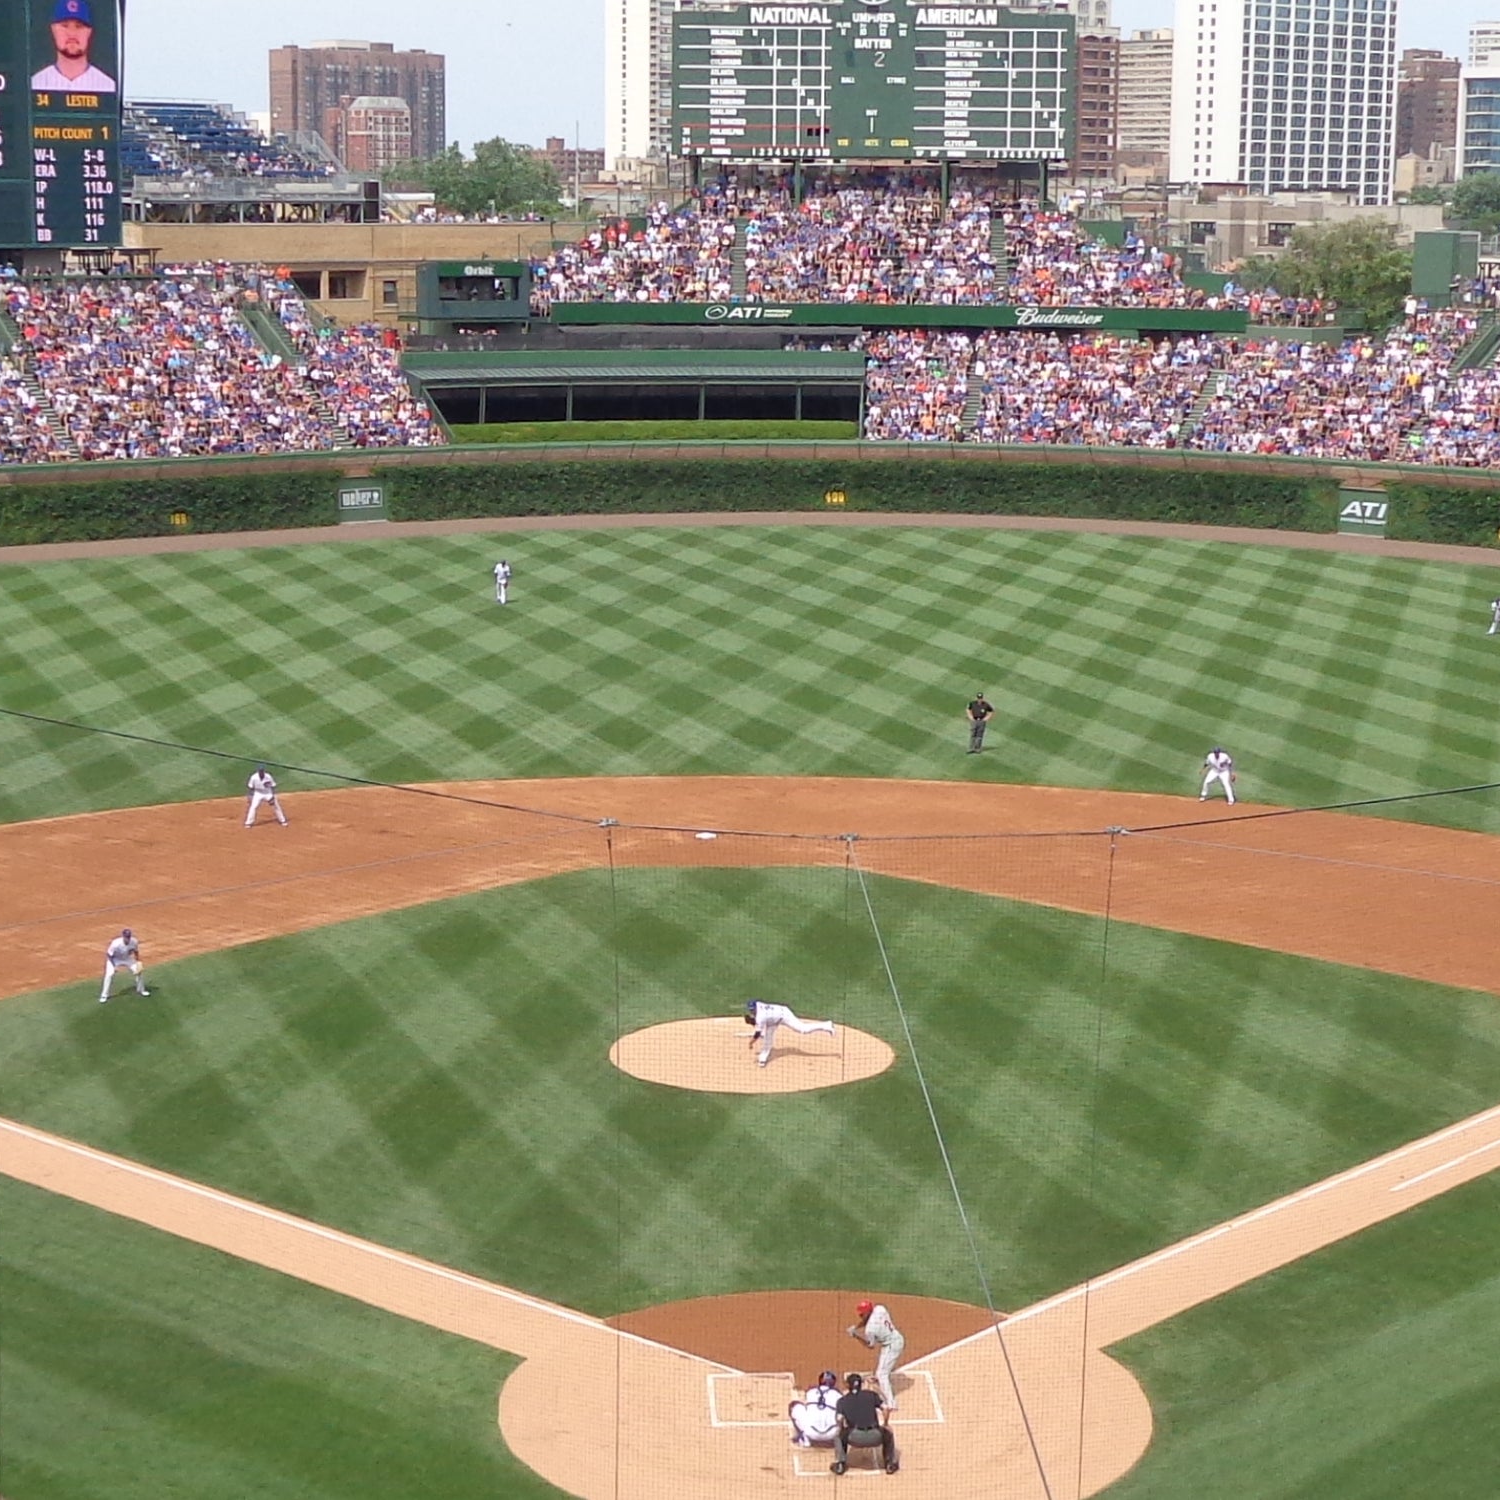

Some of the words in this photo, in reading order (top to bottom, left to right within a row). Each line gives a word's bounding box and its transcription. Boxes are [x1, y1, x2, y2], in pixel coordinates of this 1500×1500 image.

[750, 7, 832, 24] NATIONAL
[916, 8, 998, 25] AMERICAN
[854, 38, 892, 49] BATTER
[874, 52, 885, 67] 2
[36, 94, 49, 106] 34
[66, 95, 98, 108] LESTER
[34, 127, 60, 139] PITCH
[62, 128, 93, 140] COUNT
[100, 127, 108, 139] 1
[34, 149, 56, 161] W-L
[35, 165, 57, 177] ERA
[37, 182, 47, 193] IP
[36, 198, 45, 209] H
[84, 198, 104, 209] 111
[37, 213, 45, 225] K
[85, 213, 105, 226] 116
[37, 229, 52, 241] BB
[84, 229, 98, 241] 31
[464, 265, 494, 276] Orbit
[727, 307, 762, 318] ATI
[1015, 307, 1104, 325] Budweiser
[1341, 501, 1387, 518] ATI
